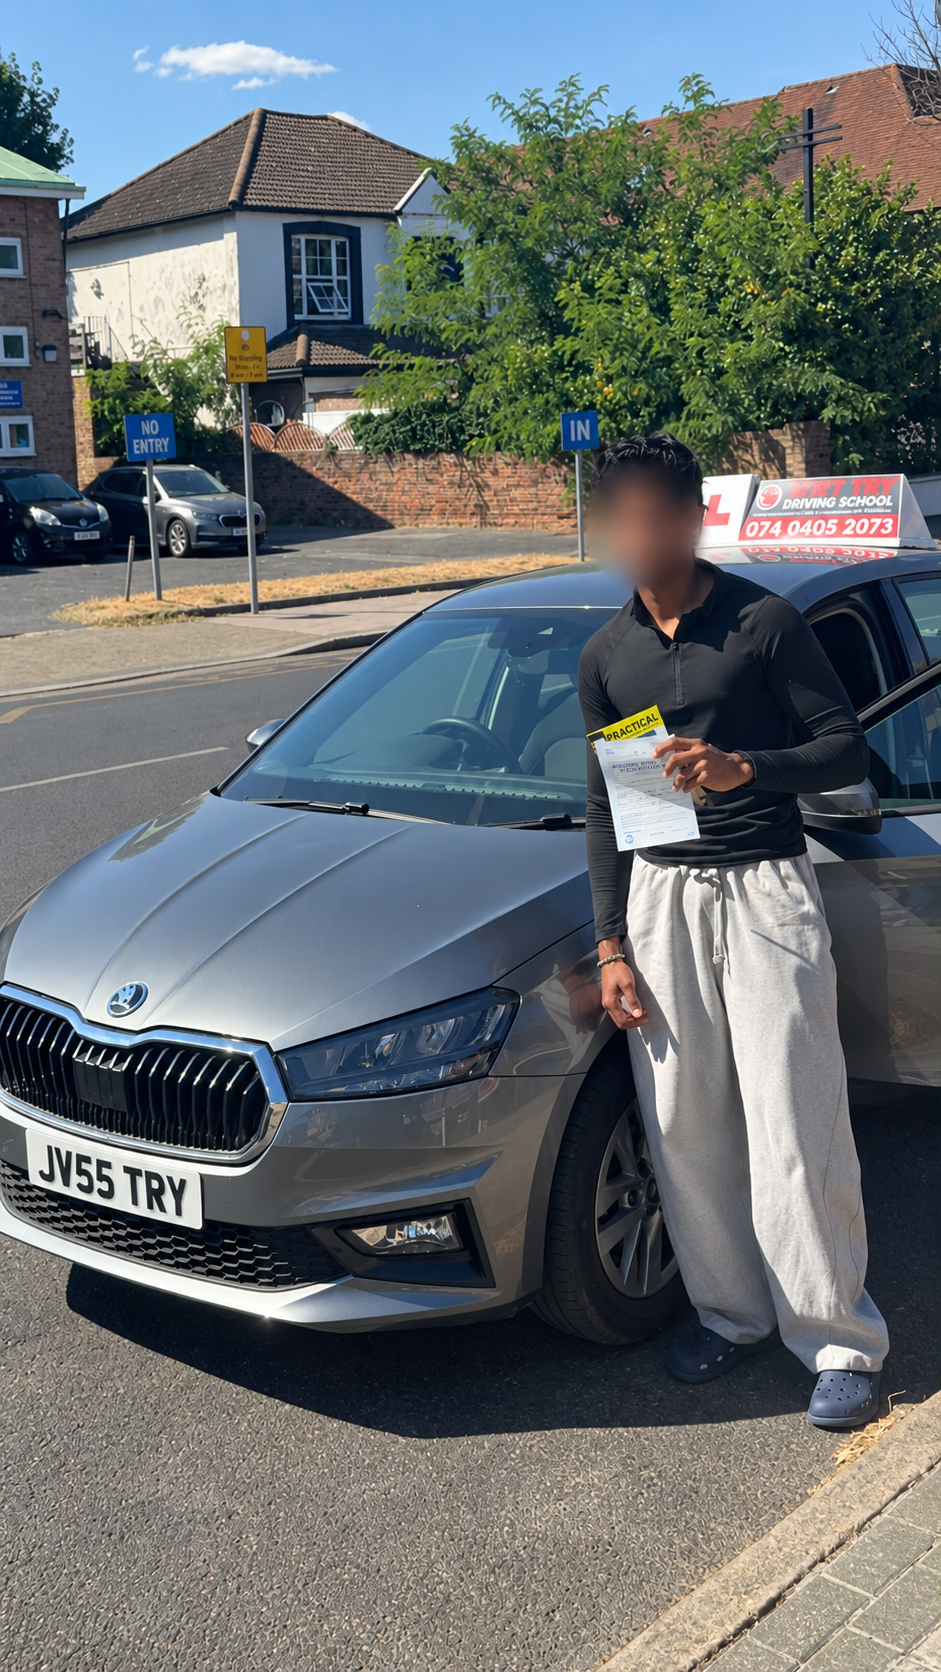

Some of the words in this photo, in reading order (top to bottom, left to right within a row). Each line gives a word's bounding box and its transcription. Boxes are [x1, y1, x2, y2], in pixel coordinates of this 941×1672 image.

[141, 419, 159, 435] NO
[570, 419, 591, 442] IN
[132, 437, 169, 454] ENTRY
[851, 476, 900, 495] TRY
[704, 494, 731, 526] L
[782, 496, 836, 510] DRIVING
[838, 495, 893, 508] SCHOOL
[745, 520, 782, 538] 074
[787, 519, 837, 537] 0405
[843, 518, 893, 535] 2073
[606, 713, 659, 742] PRACTICAL
[38, 1145, 115, 1200] JV55
[123, 1165, 187, 1217] TRY
